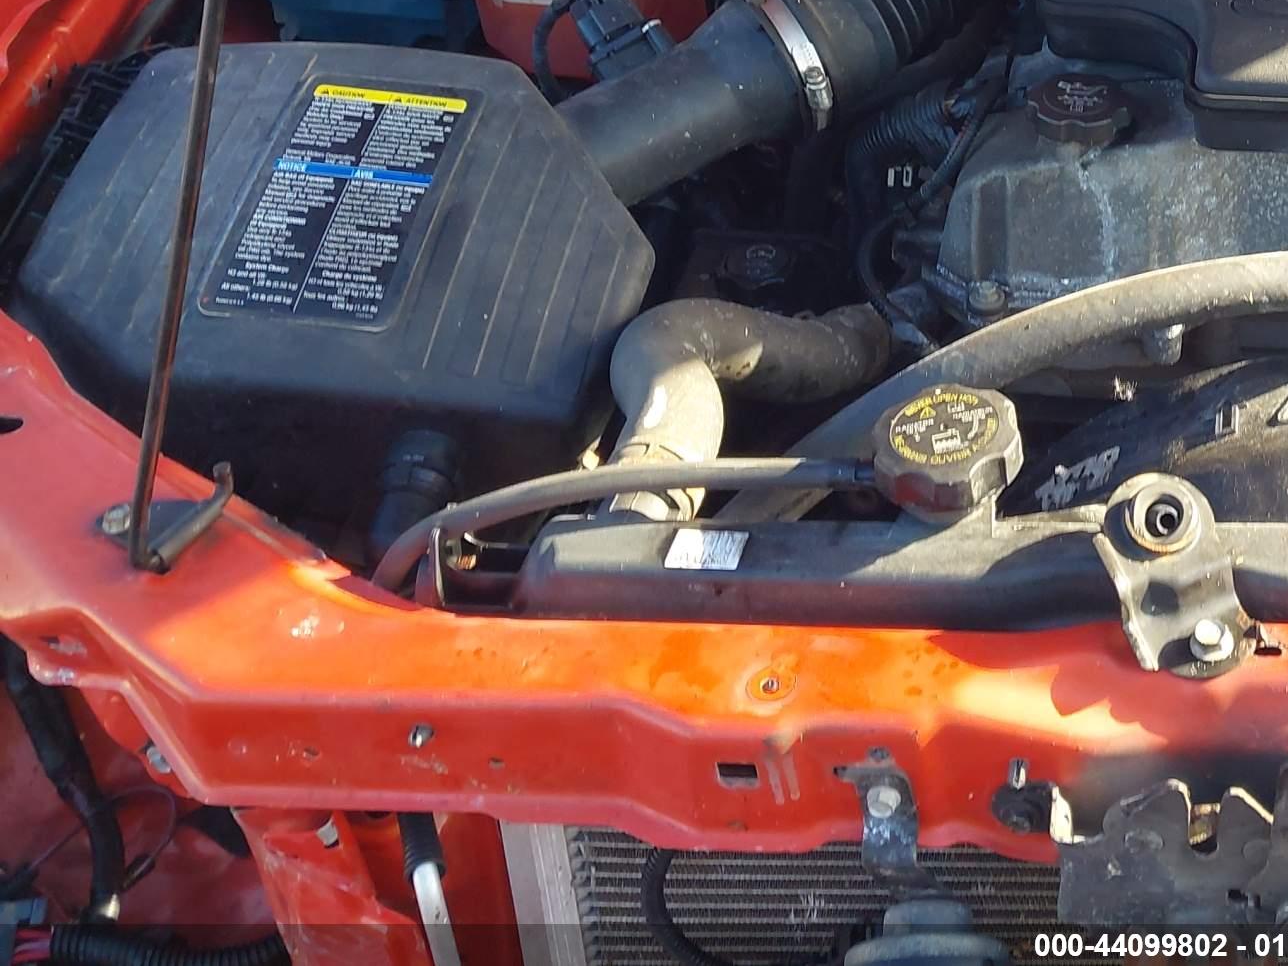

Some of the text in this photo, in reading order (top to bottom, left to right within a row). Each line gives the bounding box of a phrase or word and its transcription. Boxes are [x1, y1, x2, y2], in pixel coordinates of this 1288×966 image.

[332, 89, 365, 99] CAUTION
[405, 96, 448, 109] ATTENTION
[277, 160, 307, 173] NOTICE
[353, 168, 374, 180] AVIS
[930, 447, 972, 465] OUVRIR
